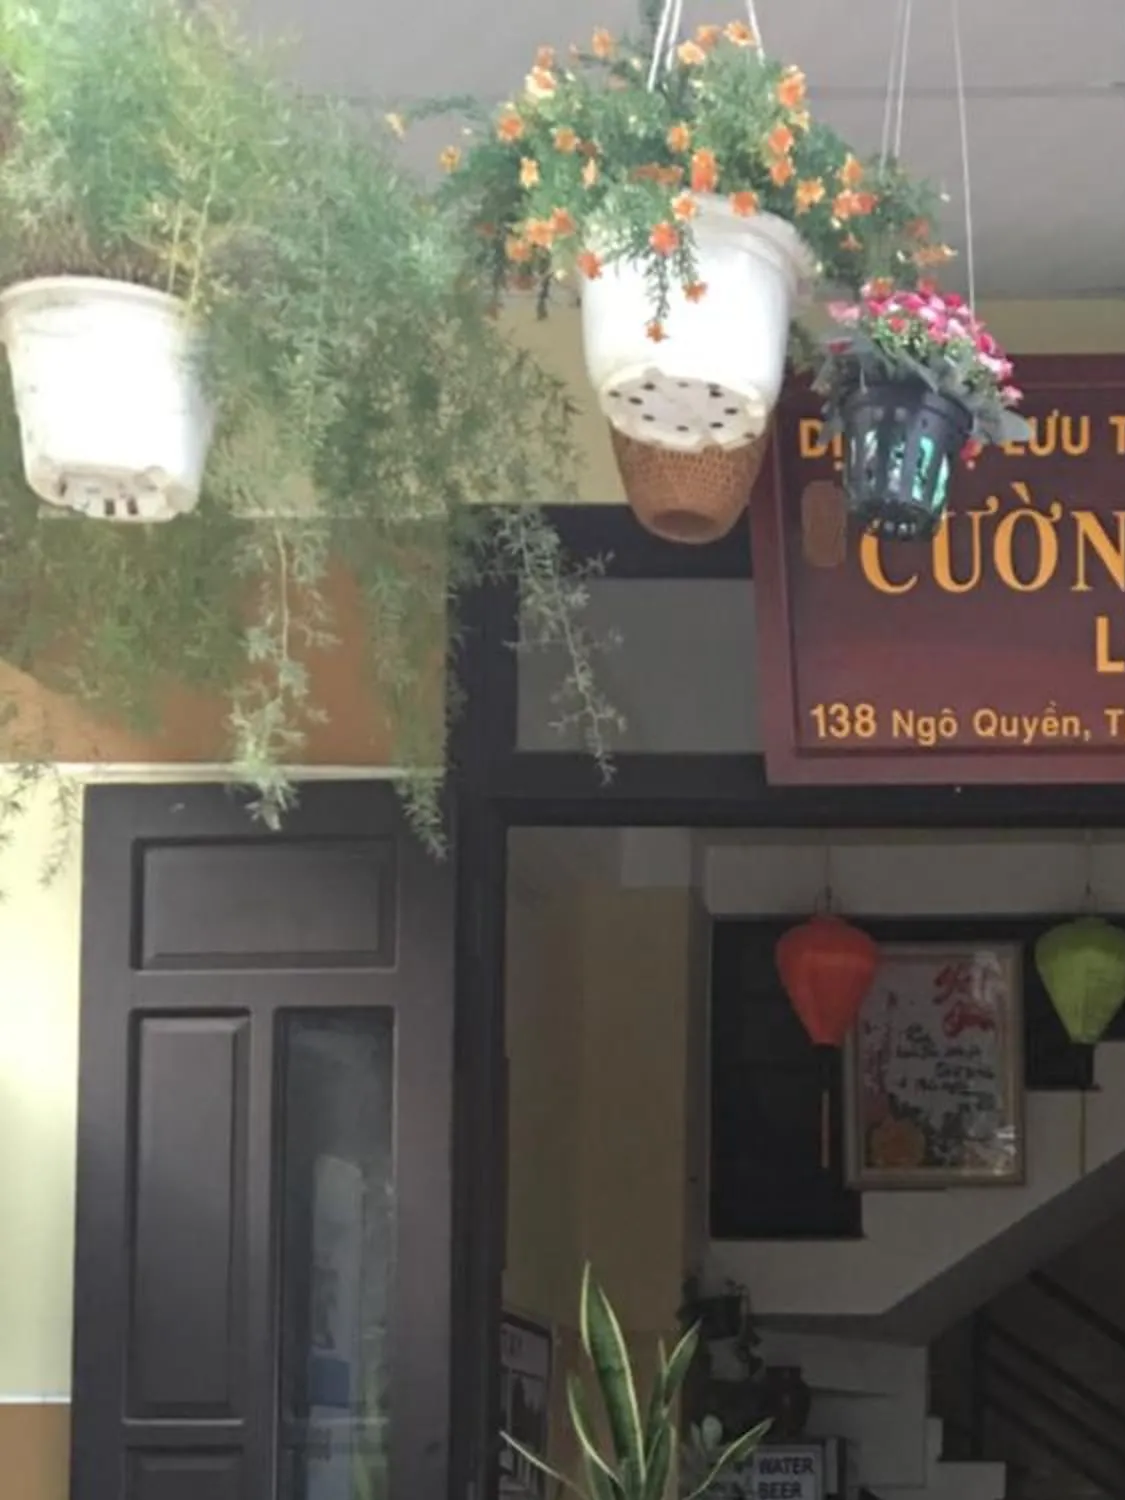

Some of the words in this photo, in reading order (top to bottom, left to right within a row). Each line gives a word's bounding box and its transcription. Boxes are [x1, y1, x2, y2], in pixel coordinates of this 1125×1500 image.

[811, 702, 878, 741] 138
[891, 706, 959, 747] Ngô
[758, 1456, 815, 1475] WATER
[758, 1481, 803, 1500] BEER
